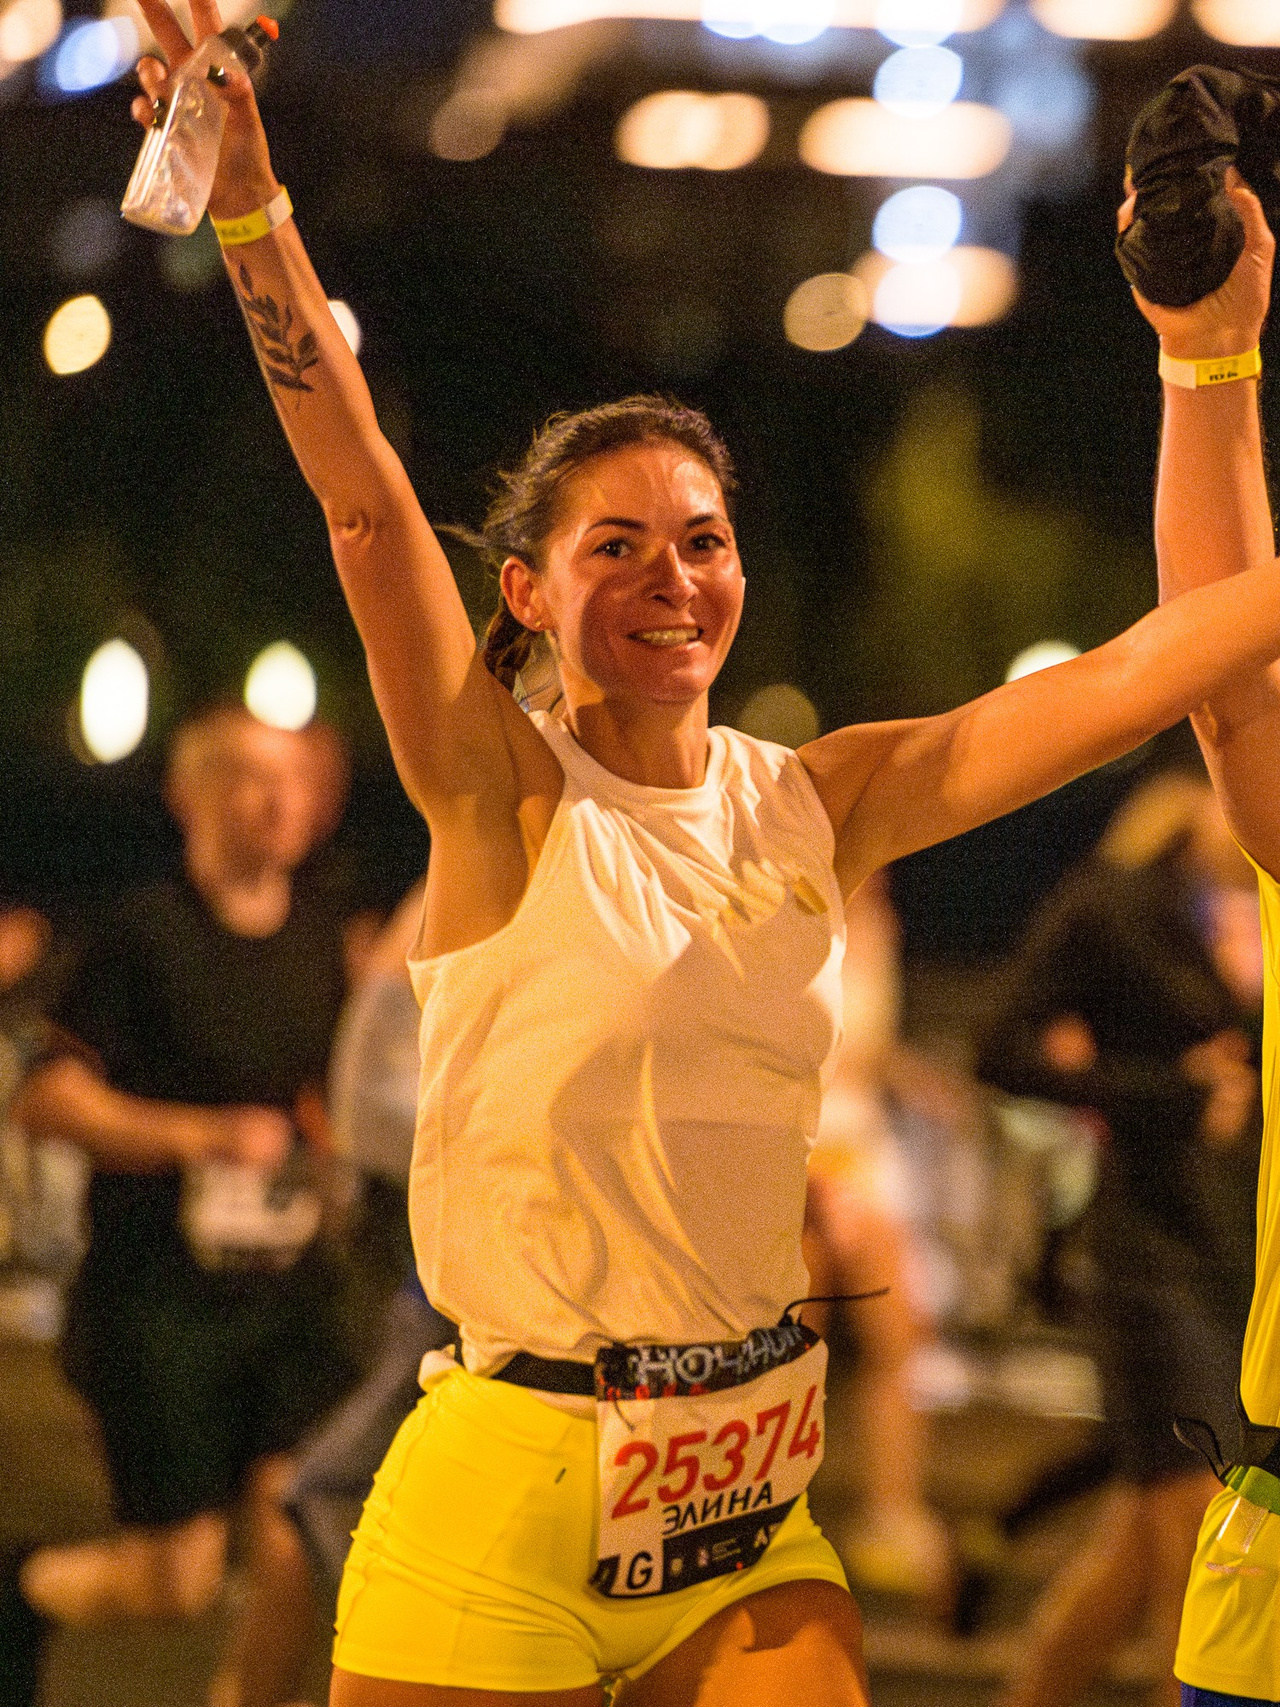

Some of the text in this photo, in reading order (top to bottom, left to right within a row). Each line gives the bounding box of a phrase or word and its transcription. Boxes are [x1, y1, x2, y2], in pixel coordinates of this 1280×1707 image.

[611, 1384, 820, 1520] 25374
[662, 1481, 773, 1535] ЭЛИНА
[626, 1552, 653, 1590] G
